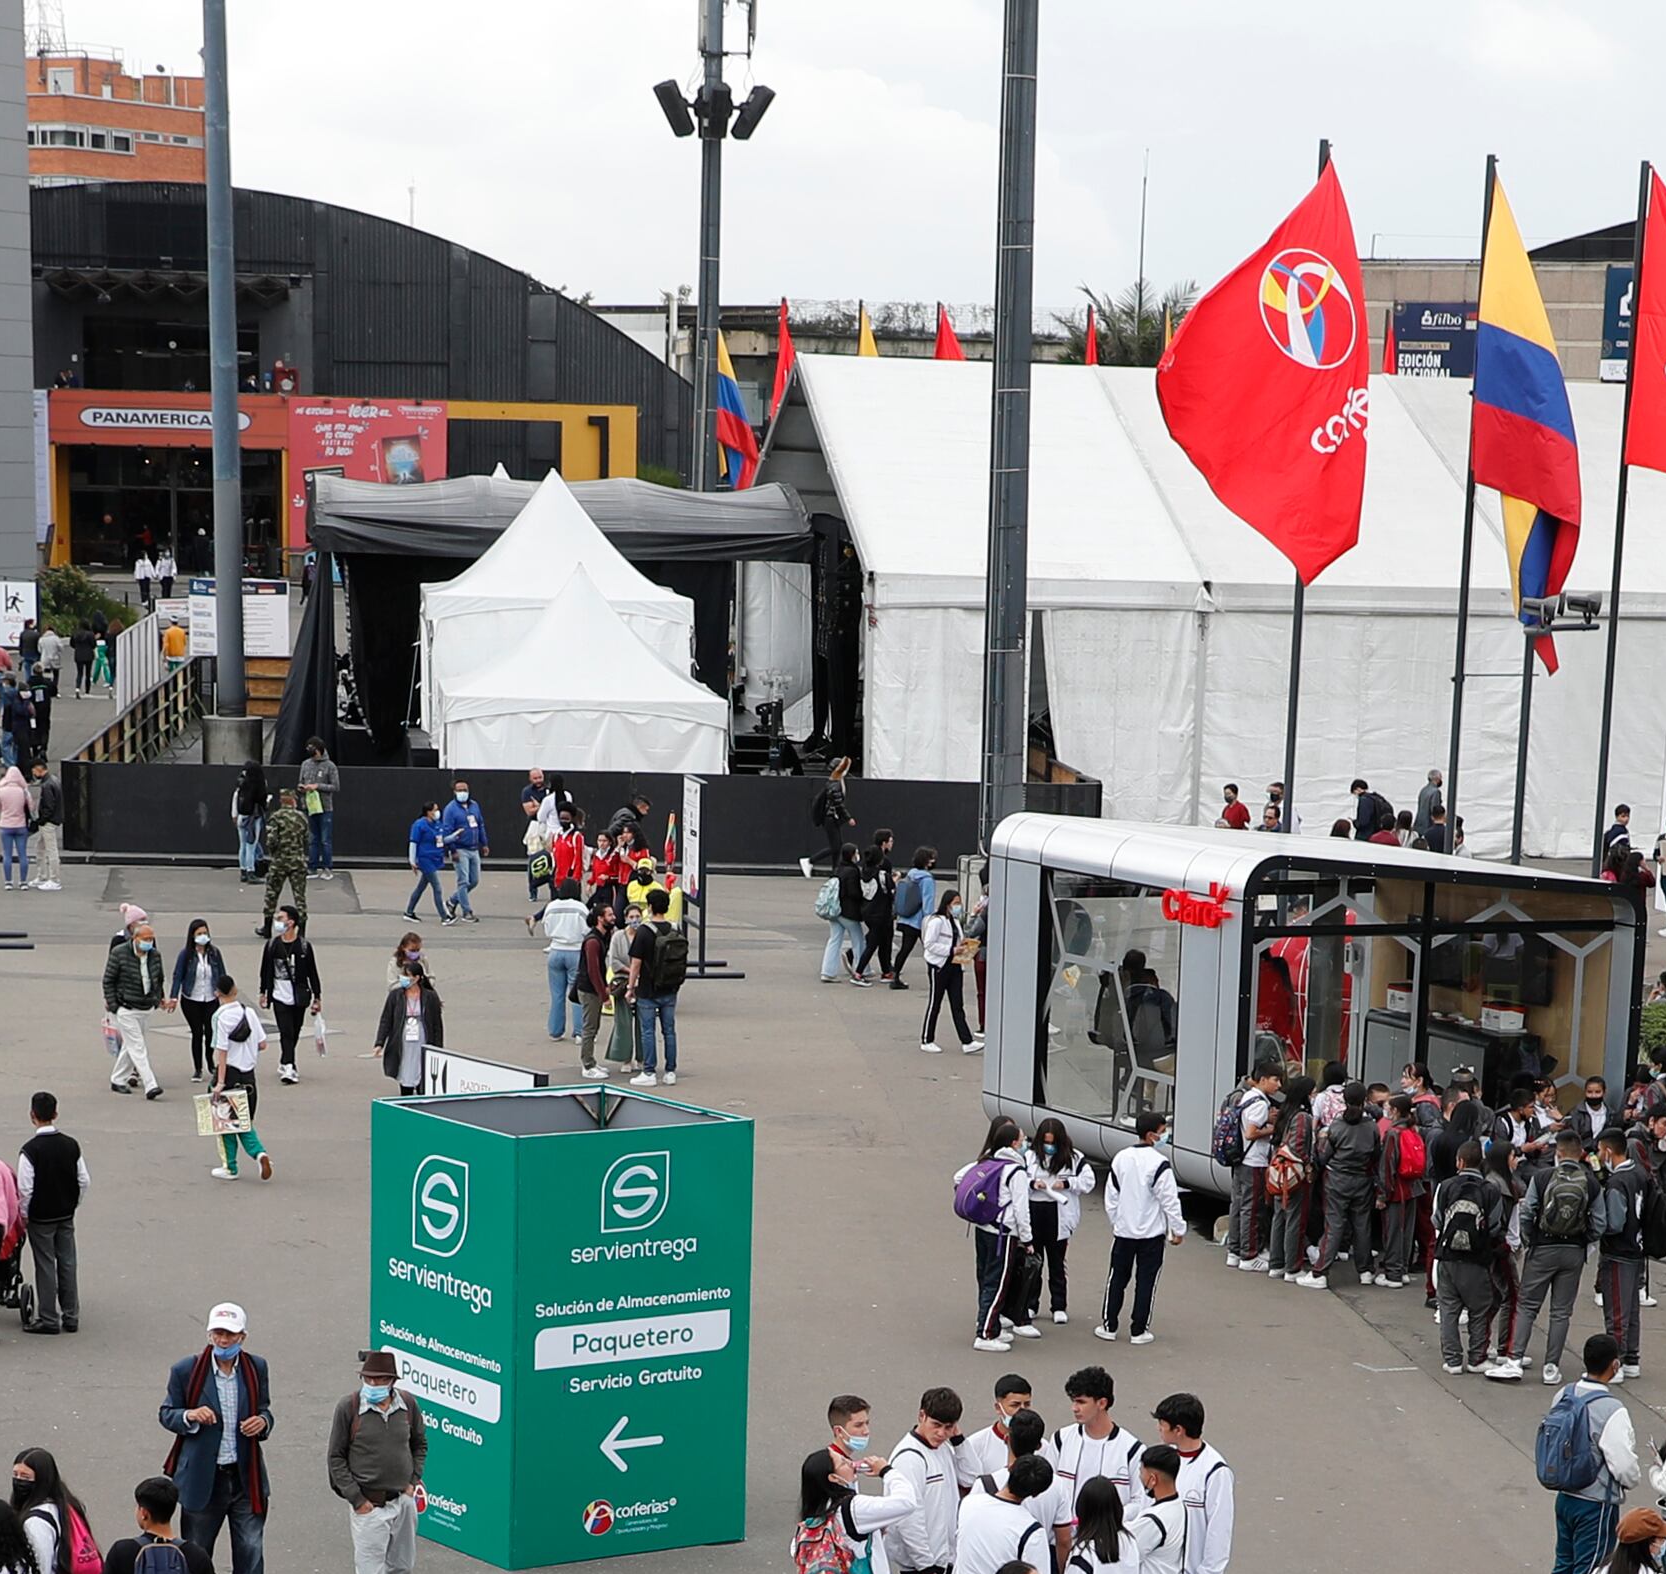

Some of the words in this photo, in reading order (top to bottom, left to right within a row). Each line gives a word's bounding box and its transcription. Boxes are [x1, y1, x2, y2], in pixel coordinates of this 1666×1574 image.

[1398, 351, 1442, 368] EDICIÓN
[1162, 888, 1221, 928] Claro
[570, 1237, 697, 1264] servientrega
[388, 1257, 492, 1314] servientrega
[535, 1300, 594, 1318] Solución
[596, 1297, 614, 1312] de
[616, 1287, 731, 1310] Almacenamiento
[379, 1319, 415, 1344] Solución
[415, 1333, 427, 1348] de
[427, 1337, 501, 1374] Almacenamiento
[572, 1326, 694, 1356] Paquetero
[401, 1360, 477, 1406] Paquetero
[569, 1372, 633, 1393] Servicio
[638, 1365, 702, 1385] Gratuito
[441, 1417, 483, 1446] Gratuito
[427, 1493, 462, 1517] corferias
[615, 1499, 669, 1519] corferias
